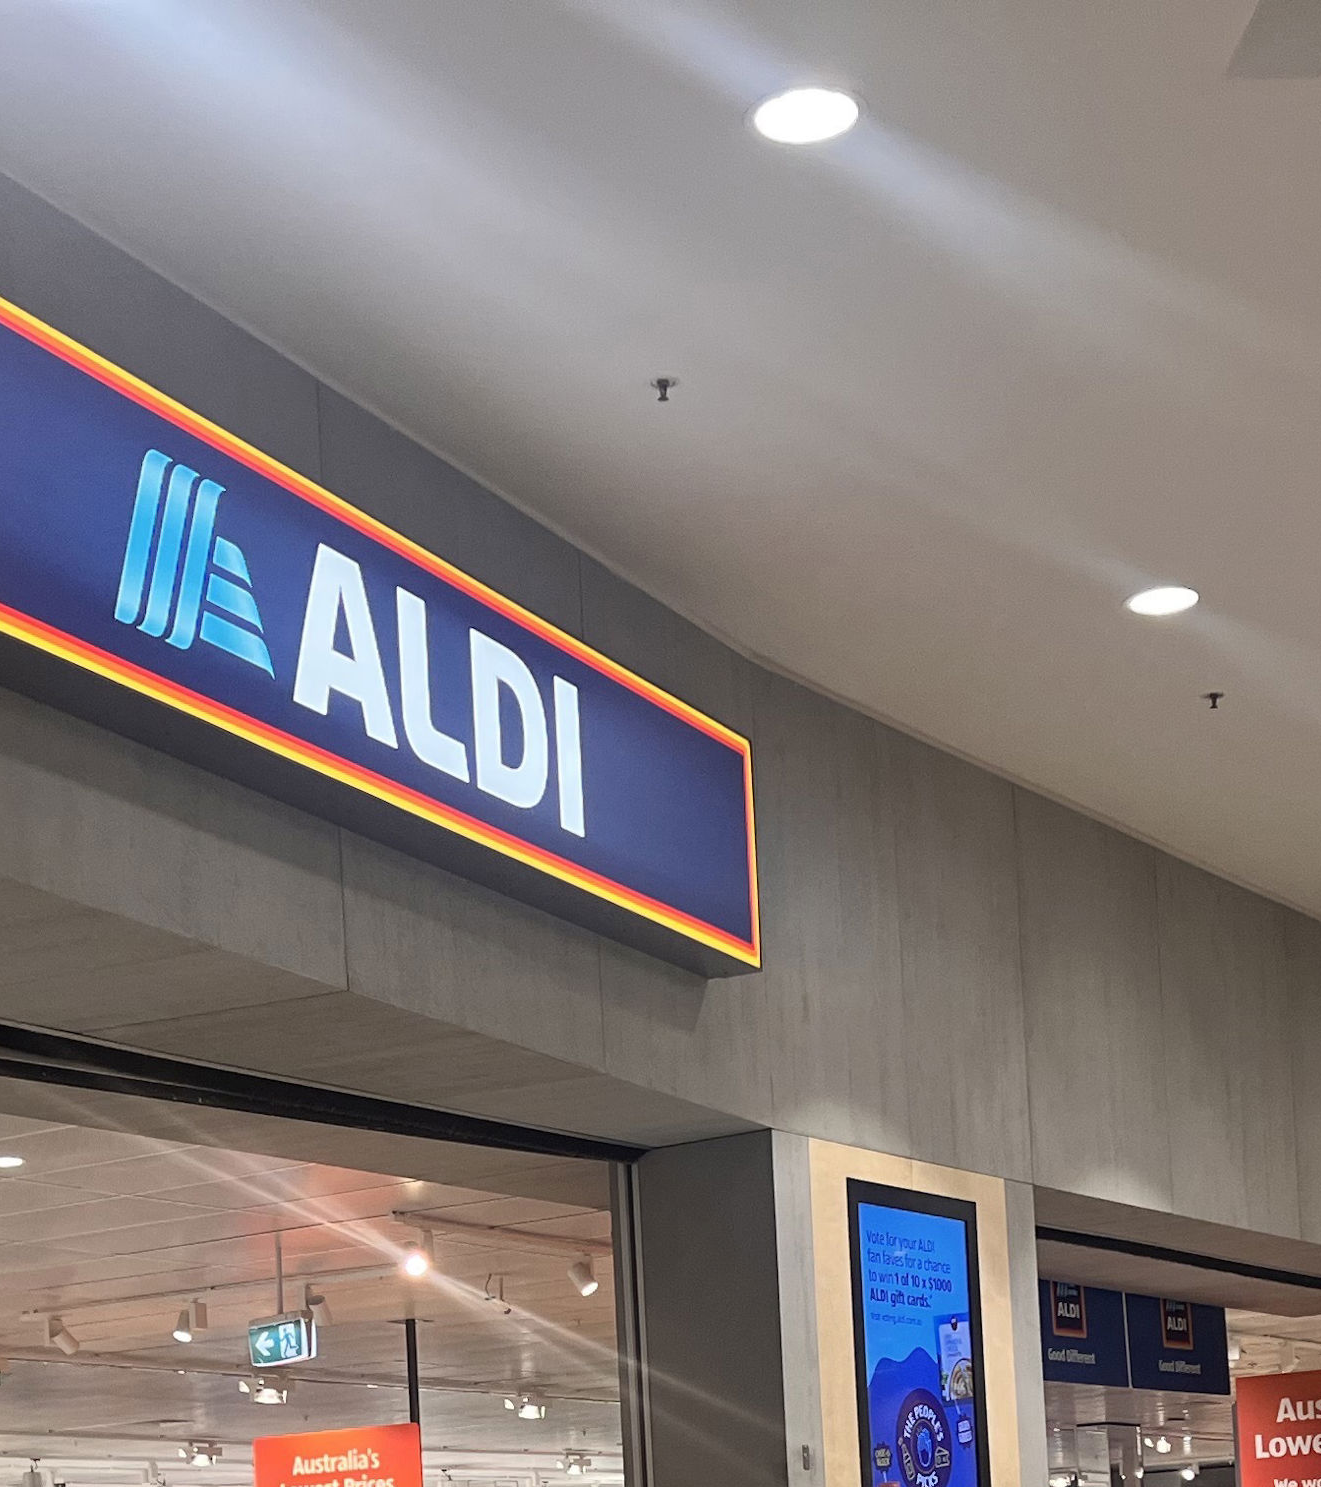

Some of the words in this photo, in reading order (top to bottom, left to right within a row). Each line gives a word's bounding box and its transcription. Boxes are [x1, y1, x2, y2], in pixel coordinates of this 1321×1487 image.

[293, 542, 585, 838] ALDI
[866, 1230, 884, 1245] Vote
[885, 1232, 897, 1247] for
[898, 1239, 916, 1251] your
[918, 1239, 935, 1253] ALDI
[867, 1247, 881, 1263] fan
[904, 1253, 917, 1269] for
[923, 1259, 951, 1274] chance
[868, 1269, 877, 1282] to
[878, 1272, 894, 1284] win
[900, 1272, 909, 1287] of
[910, 1274, 920, 1288] 10
[870, 1287, 889, 1303] ALDI
[890, 1289, 905, 1308] gift
[1057, 1301, 1080, 1319] ALDI
[1166, 1316, 1187, 1332] ALDI
[1047, 1348, 1066, 1362] Good
[903, 1411, 916, 1440] THE
[292, 1447, 380, 1476] Australia's
